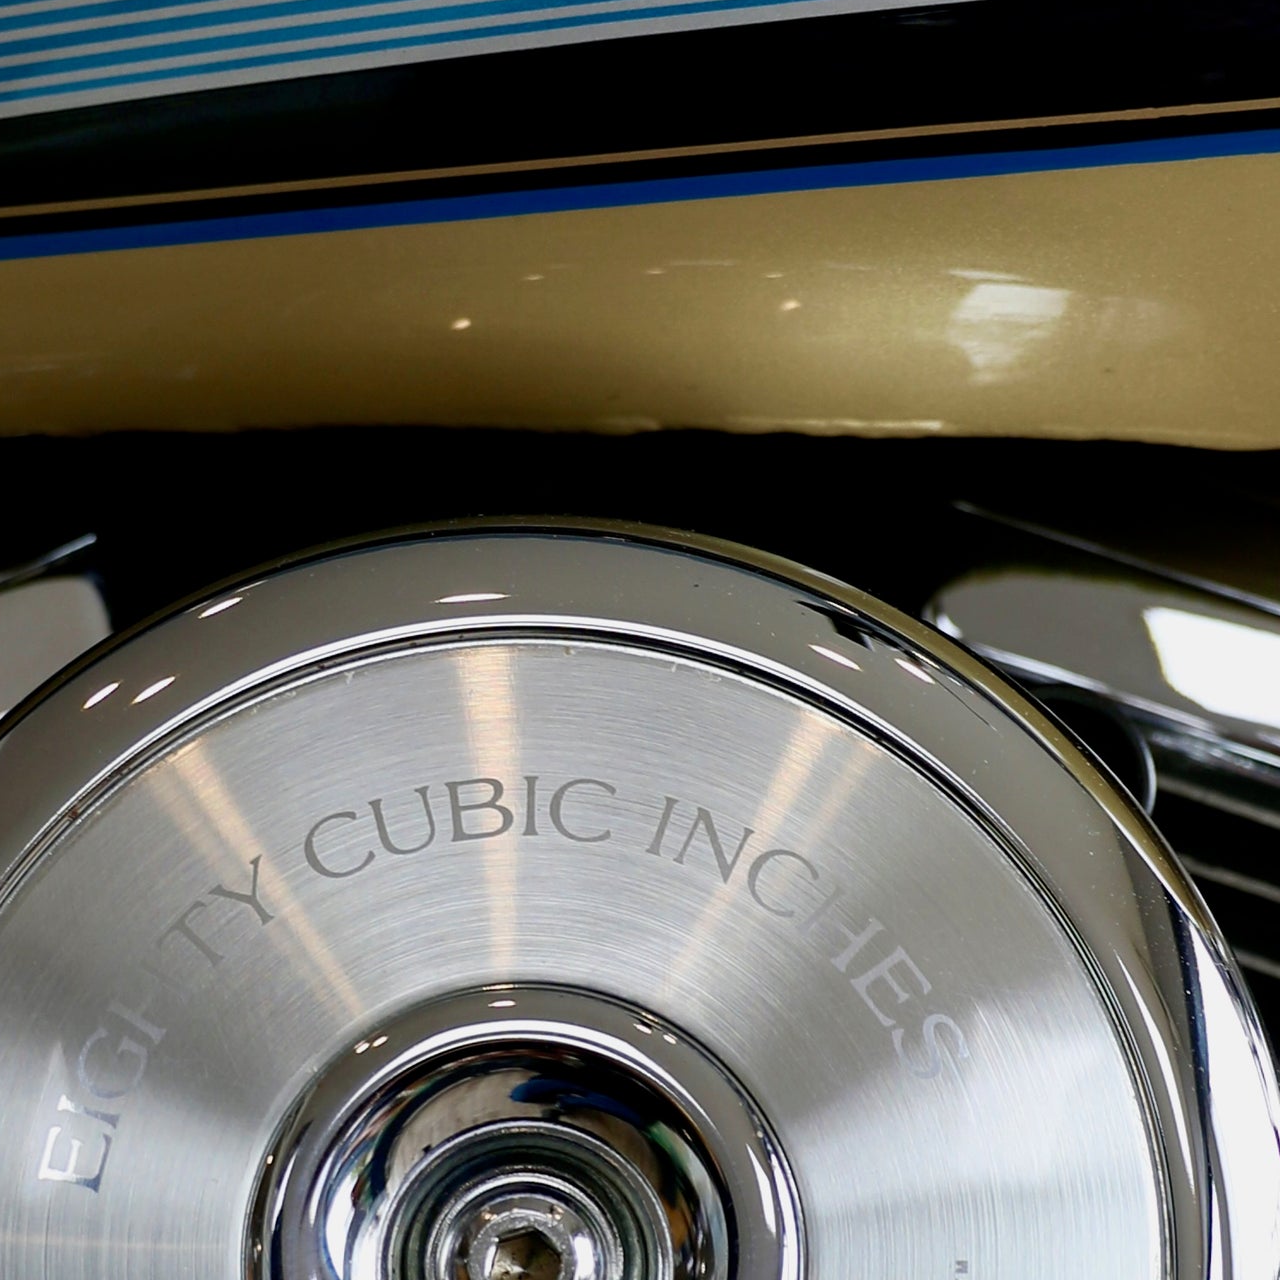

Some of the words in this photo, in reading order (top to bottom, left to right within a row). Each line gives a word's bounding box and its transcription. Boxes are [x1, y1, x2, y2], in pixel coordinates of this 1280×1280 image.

[36, 856, 277, 1194] EIGHTY
[304, 776, 618, 879] CUBIC
[646, 797, 970, 1082] INCHES
